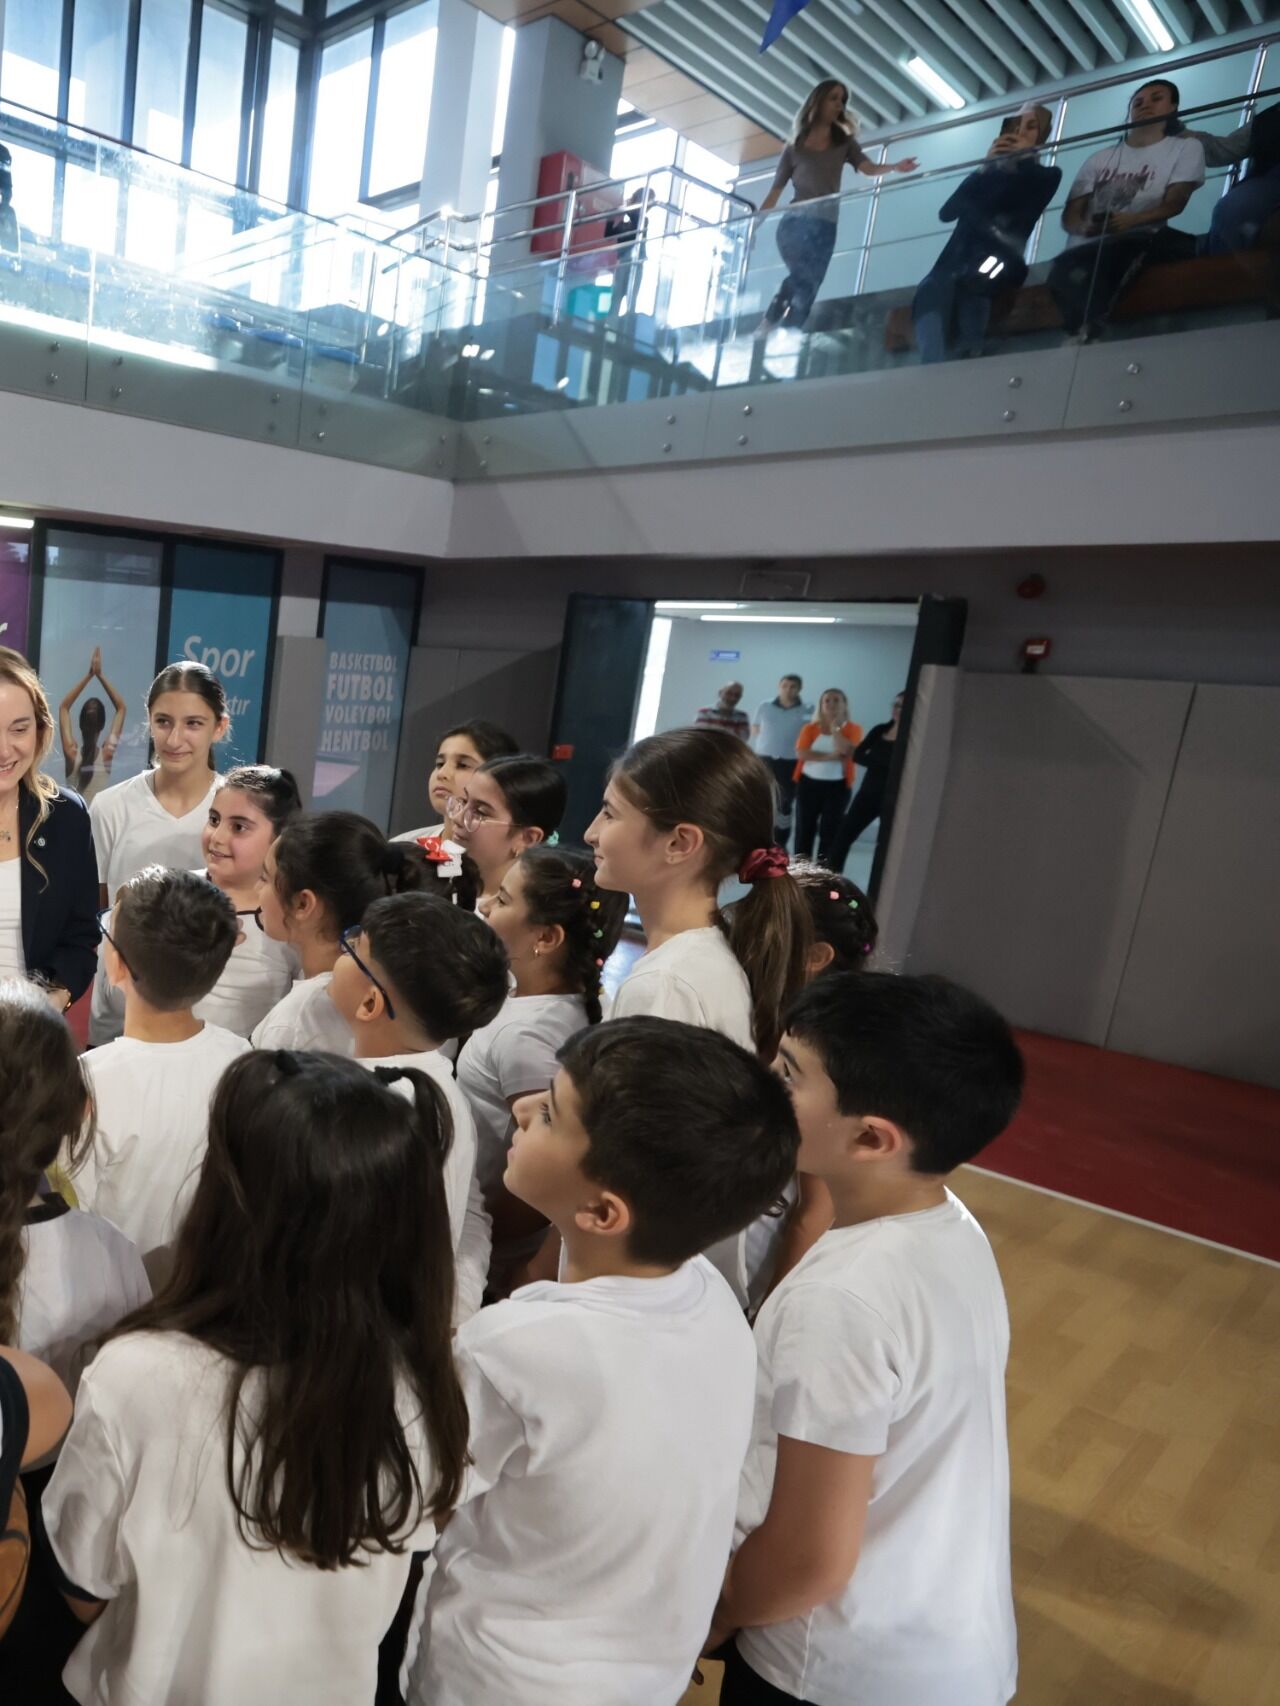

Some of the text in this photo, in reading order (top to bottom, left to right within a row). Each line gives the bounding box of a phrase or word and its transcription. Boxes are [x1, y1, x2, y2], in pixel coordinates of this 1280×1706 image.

[184, 635, 255, 678] Spor
[329, 652, 398, 673] BASKETBOL
[326, 673, 394, 701] FUTBOL
[325, 704, 391, 725] VOLEYBOL
[320, 729, 389, 752] HENTBOL
